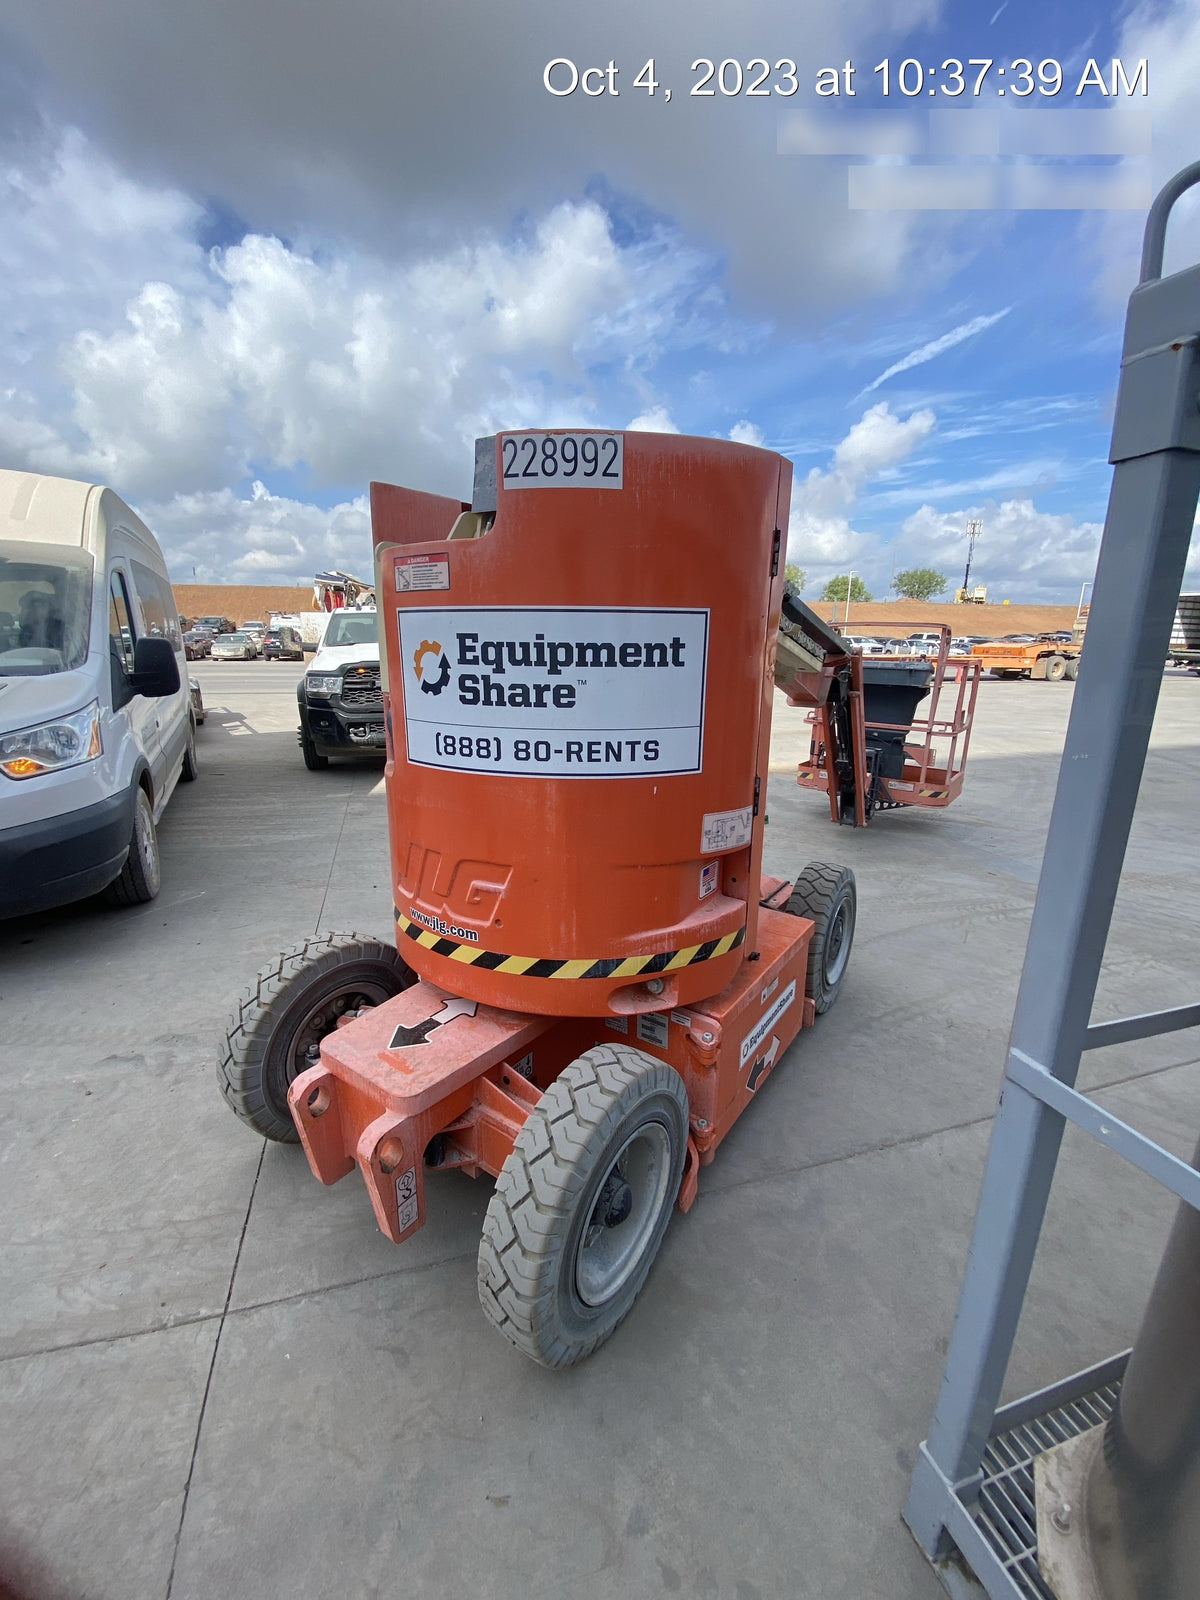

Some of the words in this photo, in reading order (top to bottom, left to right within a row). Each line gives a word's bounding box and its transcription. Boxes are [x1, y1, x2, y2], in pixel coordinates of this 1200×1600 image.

[503, 437, 619, 478] 228992
[456, 633, 686, 676] Equipment
[458, 674, 576, 709] Share
[436, 732, 502, 761] (888)
[514, 740, 660, 763] 80-RENTS
[398, 842, 513, 928] JLG
[410, 906, 479, 942] www.jlg.com
